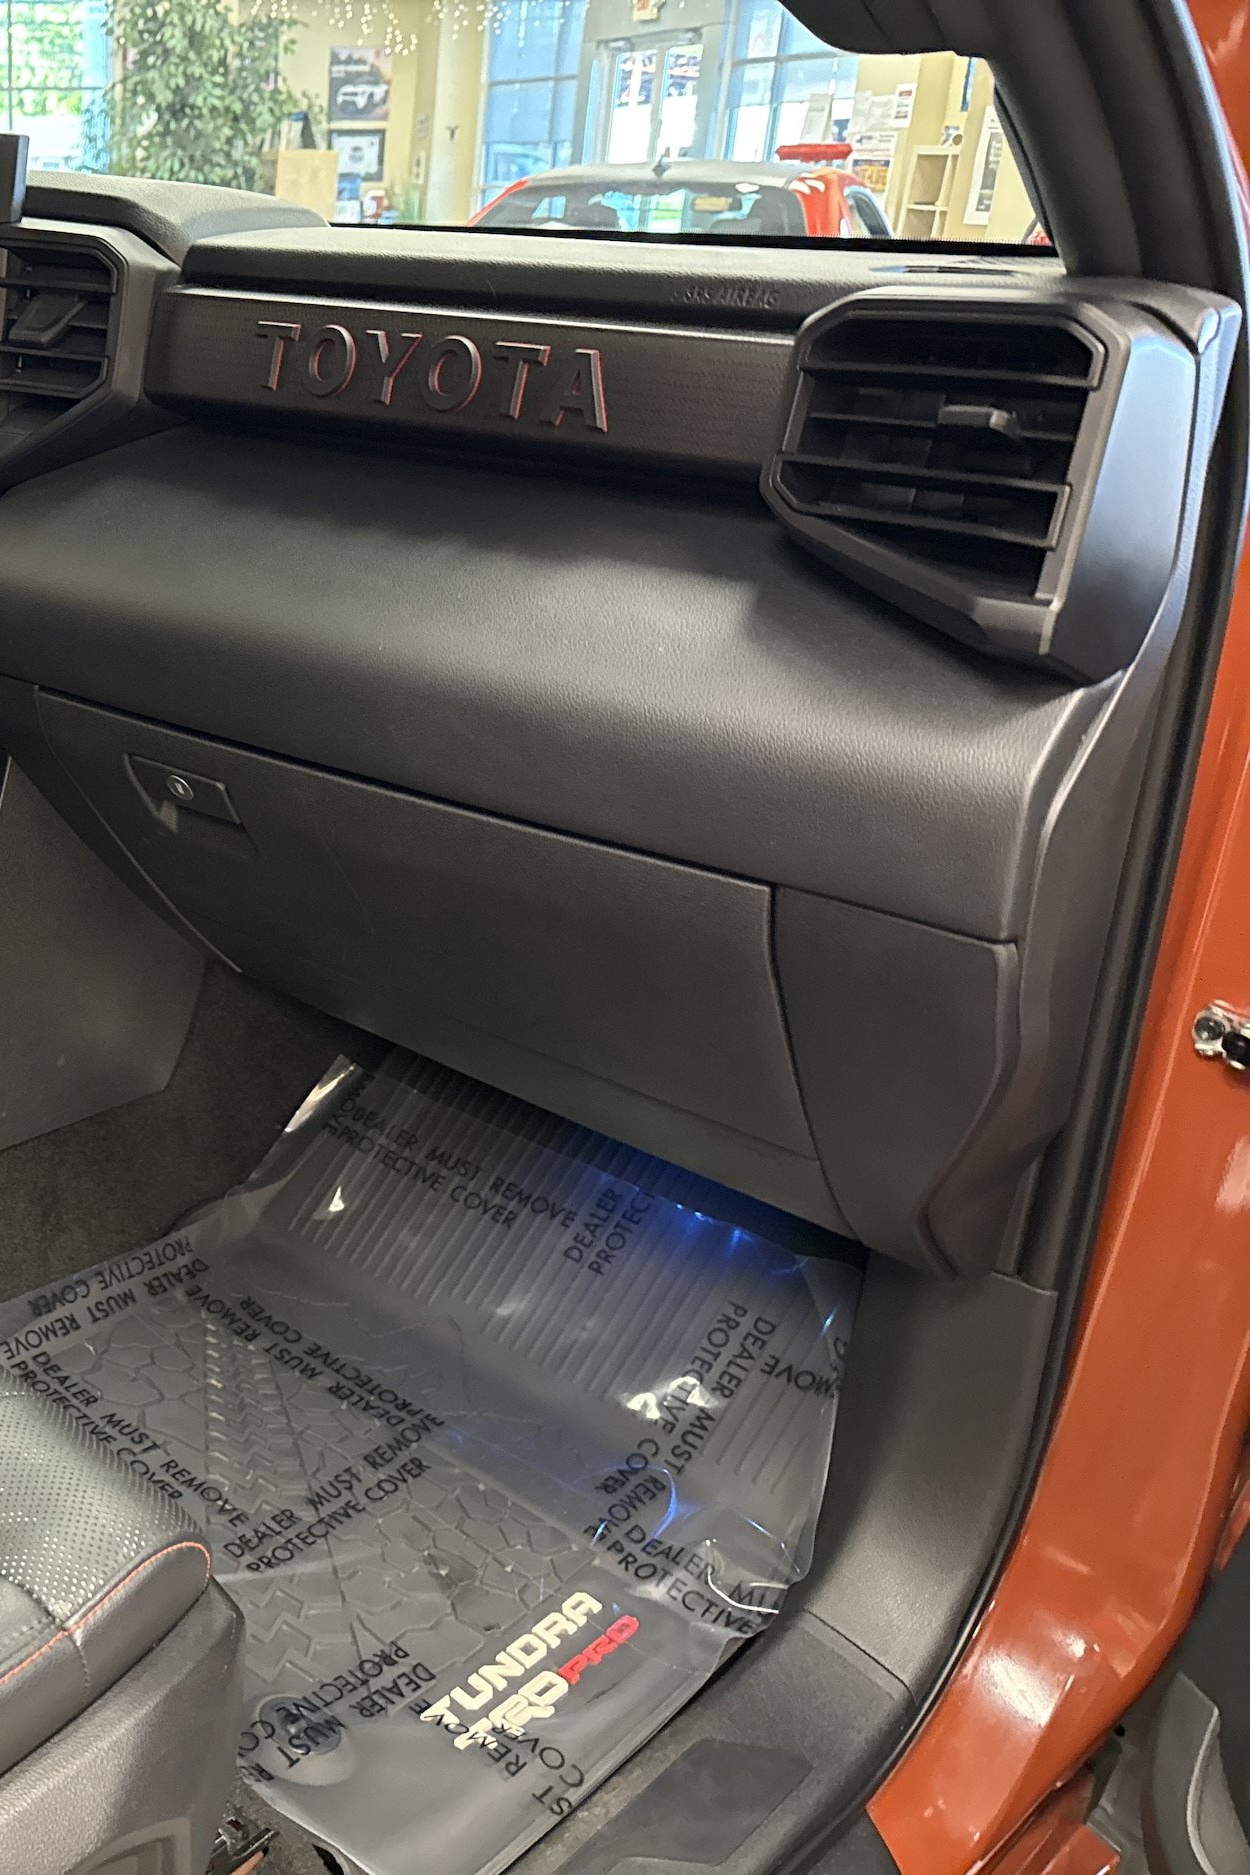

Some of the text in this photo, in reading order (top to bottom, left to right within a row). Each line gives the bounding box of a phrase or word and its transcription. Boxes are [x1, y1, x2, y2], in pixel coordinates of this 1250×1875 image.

[256, 320, 609, 433] TOYOTA
[336, 1127, 518, 1230] PROTECTIVE COVER
[351, 1107, 578, 1229] DEALER MUST REMOVE
[27, 1236, 194, 1318] PROTECTIVE COVER
[562, 1187, 623, 1264] DEALER
[0, 1258, 209, 1361] DEALER MUST REMOVE
[184, 1285, 406, 1429] DEALER MUST REMOVE
[238, 1295, 425, 1417] PROTECTIVE COVER
[10, 1361, 117, 1447] PROTECTIVE
[31, 1351, 250, 1529] DEALER MUST REMOVE
[583, 1314, 778, 1543] DEALER MUST REMOVE
[223, 1413, 446, 1561] DEALER MUST REMOVE
[245, 1455, 433, 1574] PROTECTIVE COVER
[594, 1437, 660, 1495] COVER
[606, 1540, 756, 1635] PROTECTIVE
[624, 1525, 717, 1588] DEALER
[348, 1660, 437, 1719] DEALER
[420, 1591, 604, 1725] TUNDRA
[453, 1614, 641, 1751] TRD PRO
[277, 1714, 348, 1769] MUST
[408, 1698, 529, 1778] REMOVE
[490, 1722, 585, 1789] COVER
